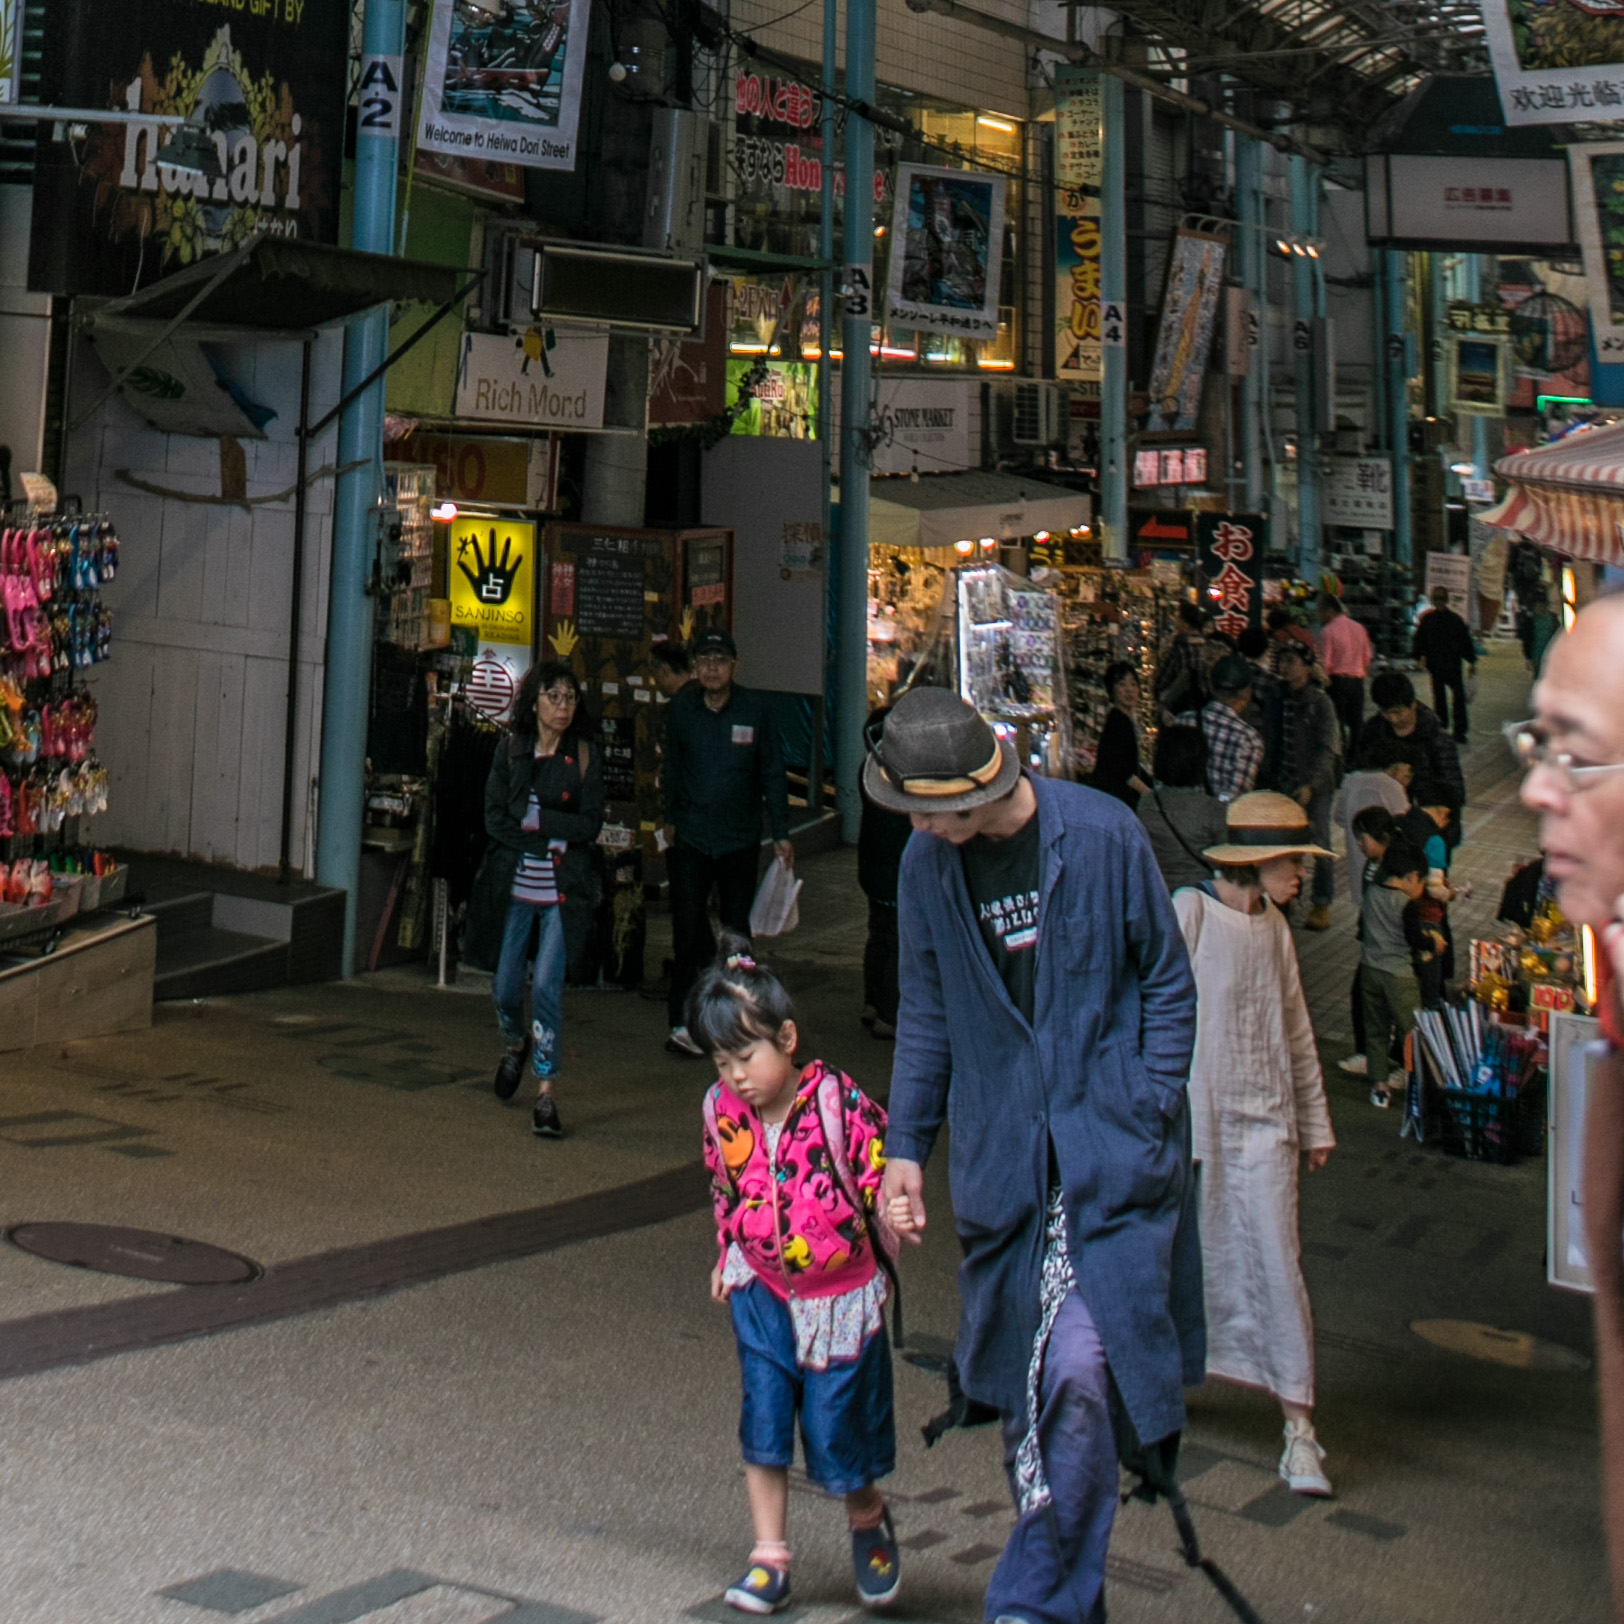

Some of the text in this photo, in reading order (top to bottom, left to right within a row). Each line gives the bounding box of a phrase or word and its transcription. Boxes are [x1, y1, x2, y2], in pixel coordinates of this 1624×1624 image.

[360, 58, 397, 129] A2
[1509, 79, 1624, 111] 欢迎光临
[424, 121, 570, 160] Welcome to Heiwa Dori Street
[846, 267, 870, 317] A3
[1102, 305, 1124, 344] A4
[475, 378, 522, 414] Rich
[481, 571, 505, 600] 占
[455, 604, 525, 624] SANJINSO
